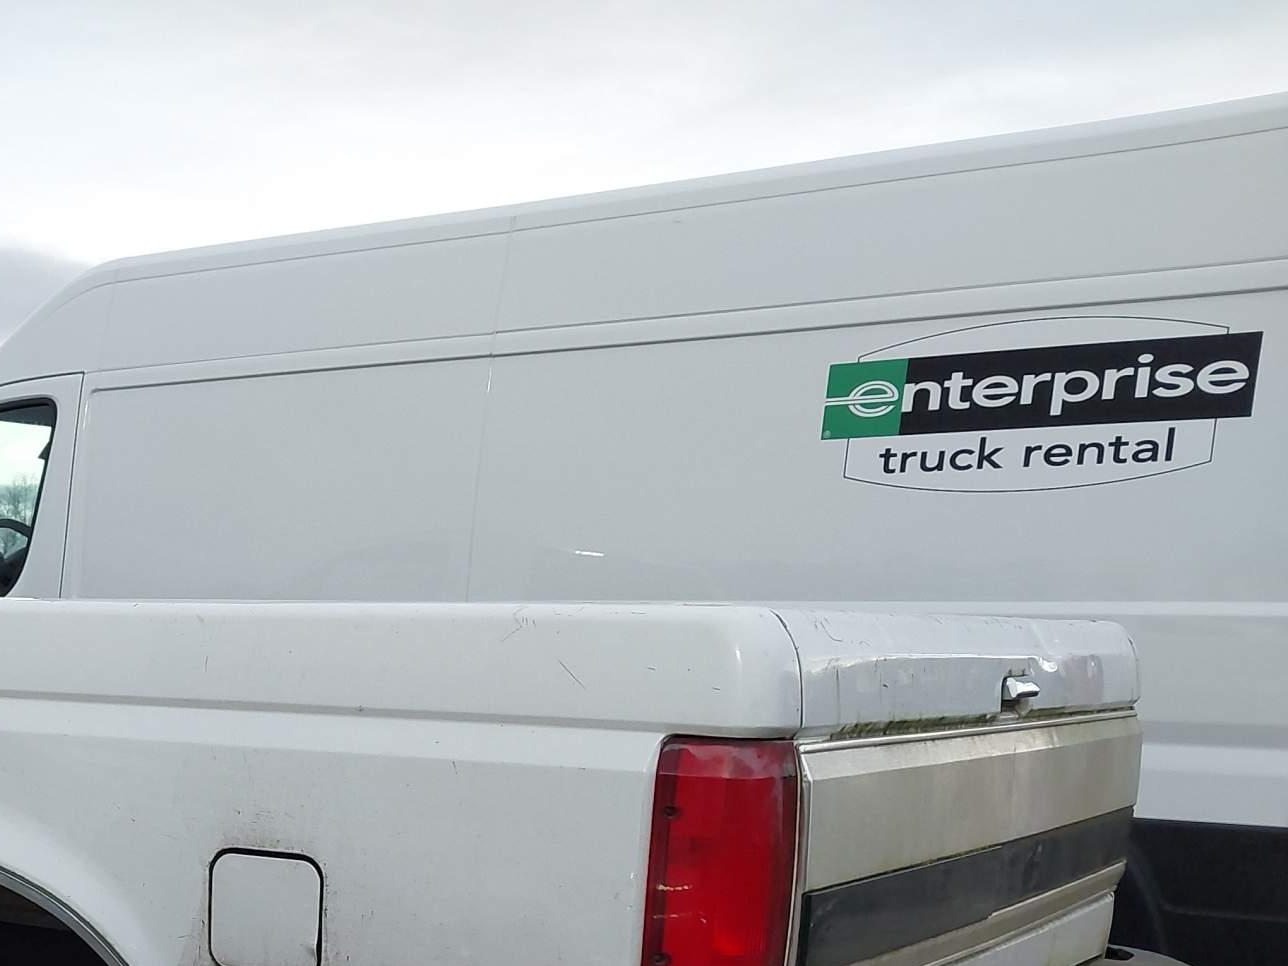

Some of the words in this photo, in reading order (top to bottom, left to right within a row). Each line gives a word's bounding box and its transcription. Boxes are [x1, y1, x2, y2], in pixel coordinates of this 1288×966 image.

[846, 353, 1250, 418] enterprise
[879, 436, 1004, 474] truck
[1022, 427, 1176, 468] rental
